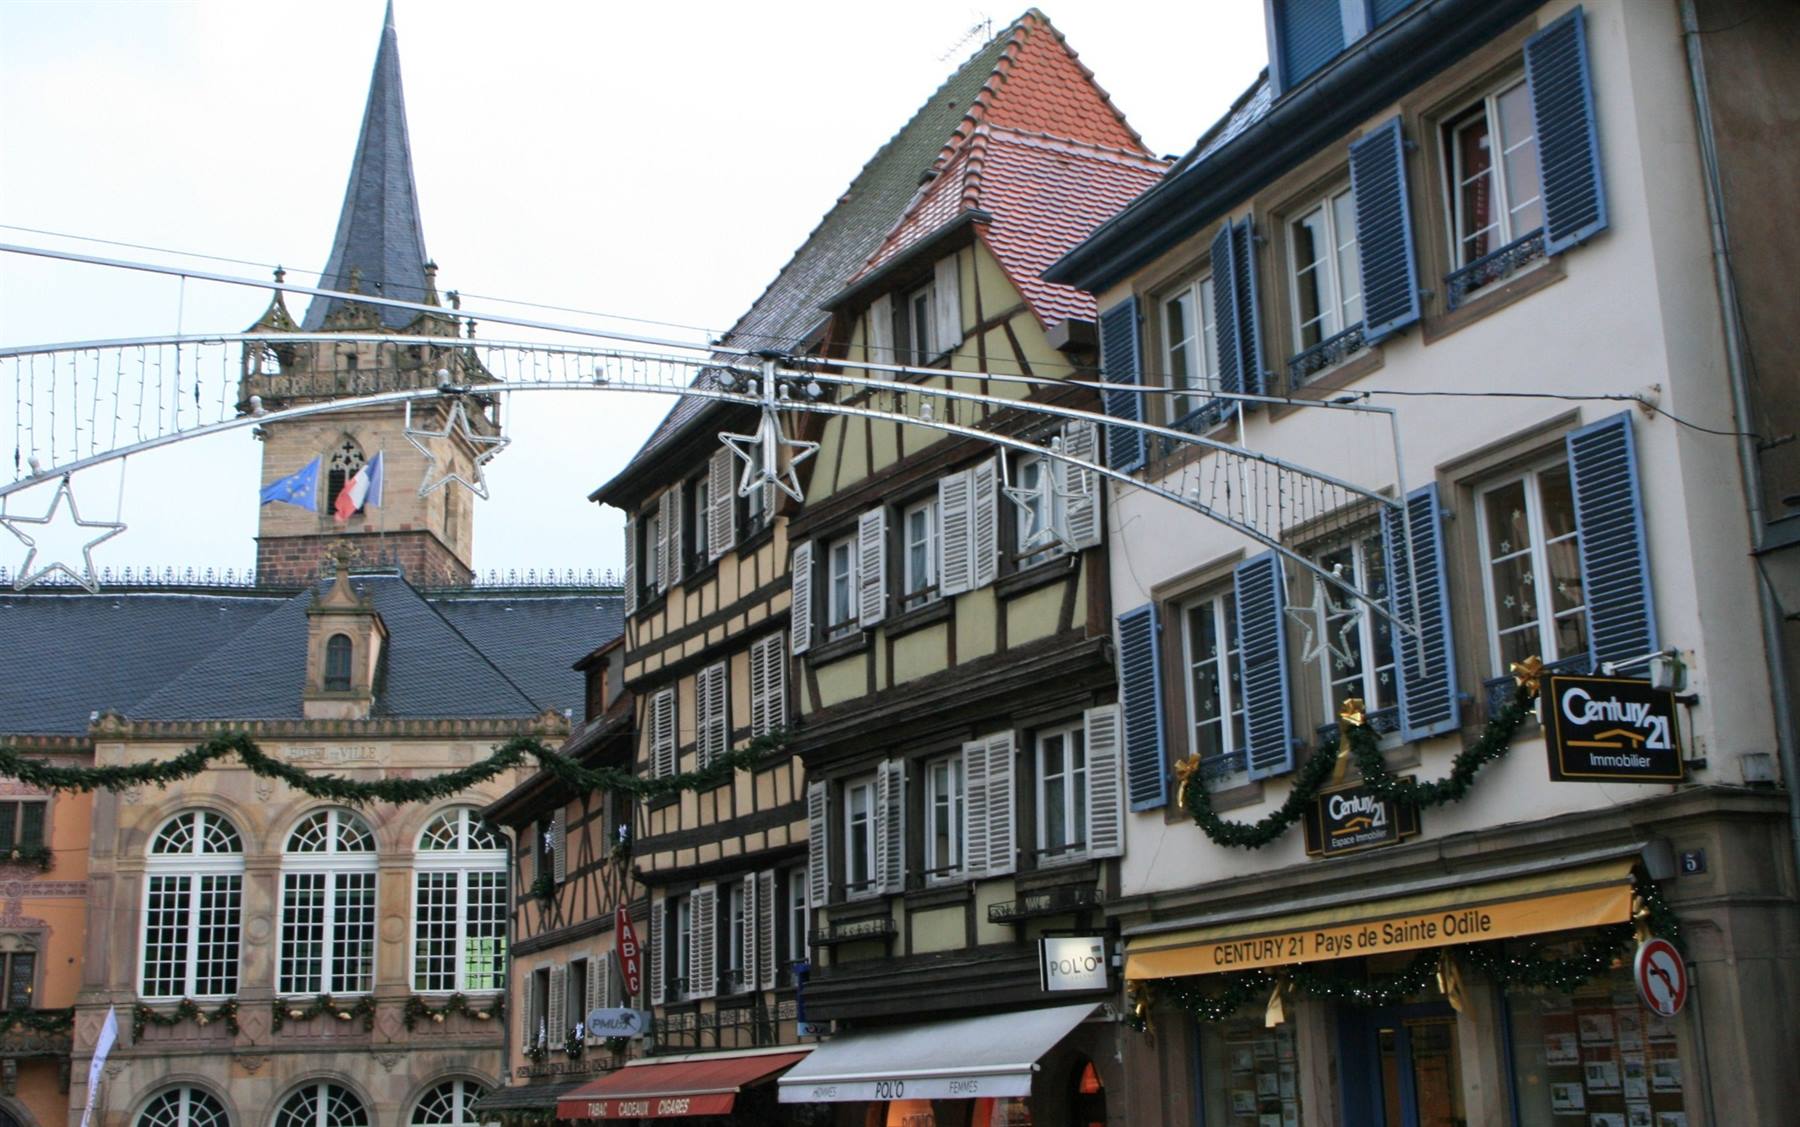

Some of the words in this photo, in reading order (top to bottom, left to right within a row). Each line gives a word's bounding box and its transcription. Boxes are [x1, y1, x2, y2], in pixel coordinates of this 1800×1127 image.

[1562, 687, 1651, 727] Century
[1643, 715, 1671, 750] 21
[340, 746, 377, 760] VILLE
[1590, 752, 1651, 768] Immobilier
[1329, 795, 1375, 820] Century
[1371, 802, 1386, 827] 21
[1331, 836, 1356, 847] Espace
[1355, 830, 1387, 842] Immobilier
[1686, 853, 1697, 871] 5
[1214, 938, 1284, 965] CENTURY
[1288, 936, 1304, 956] 21
[1315, 933, 1353, 956] Pays
[1357, 926, 1378, 948] de
[1382, 920, 1437, 945] Sainte
[1442, 910, 1491, 937] Odile
[620, 908, 639, 991] TABAC
[1050, 956, 1097, 976] POL'O
[875, 1080, 904, 1099] POL'O
[949, 1080, 979, 1095] FEMMES
[587, 1102, 608, 1116] TABAC
[618, 1101, 650, 1117] CADEAUX
[658, 1098, 690, 1115] CIGARES
